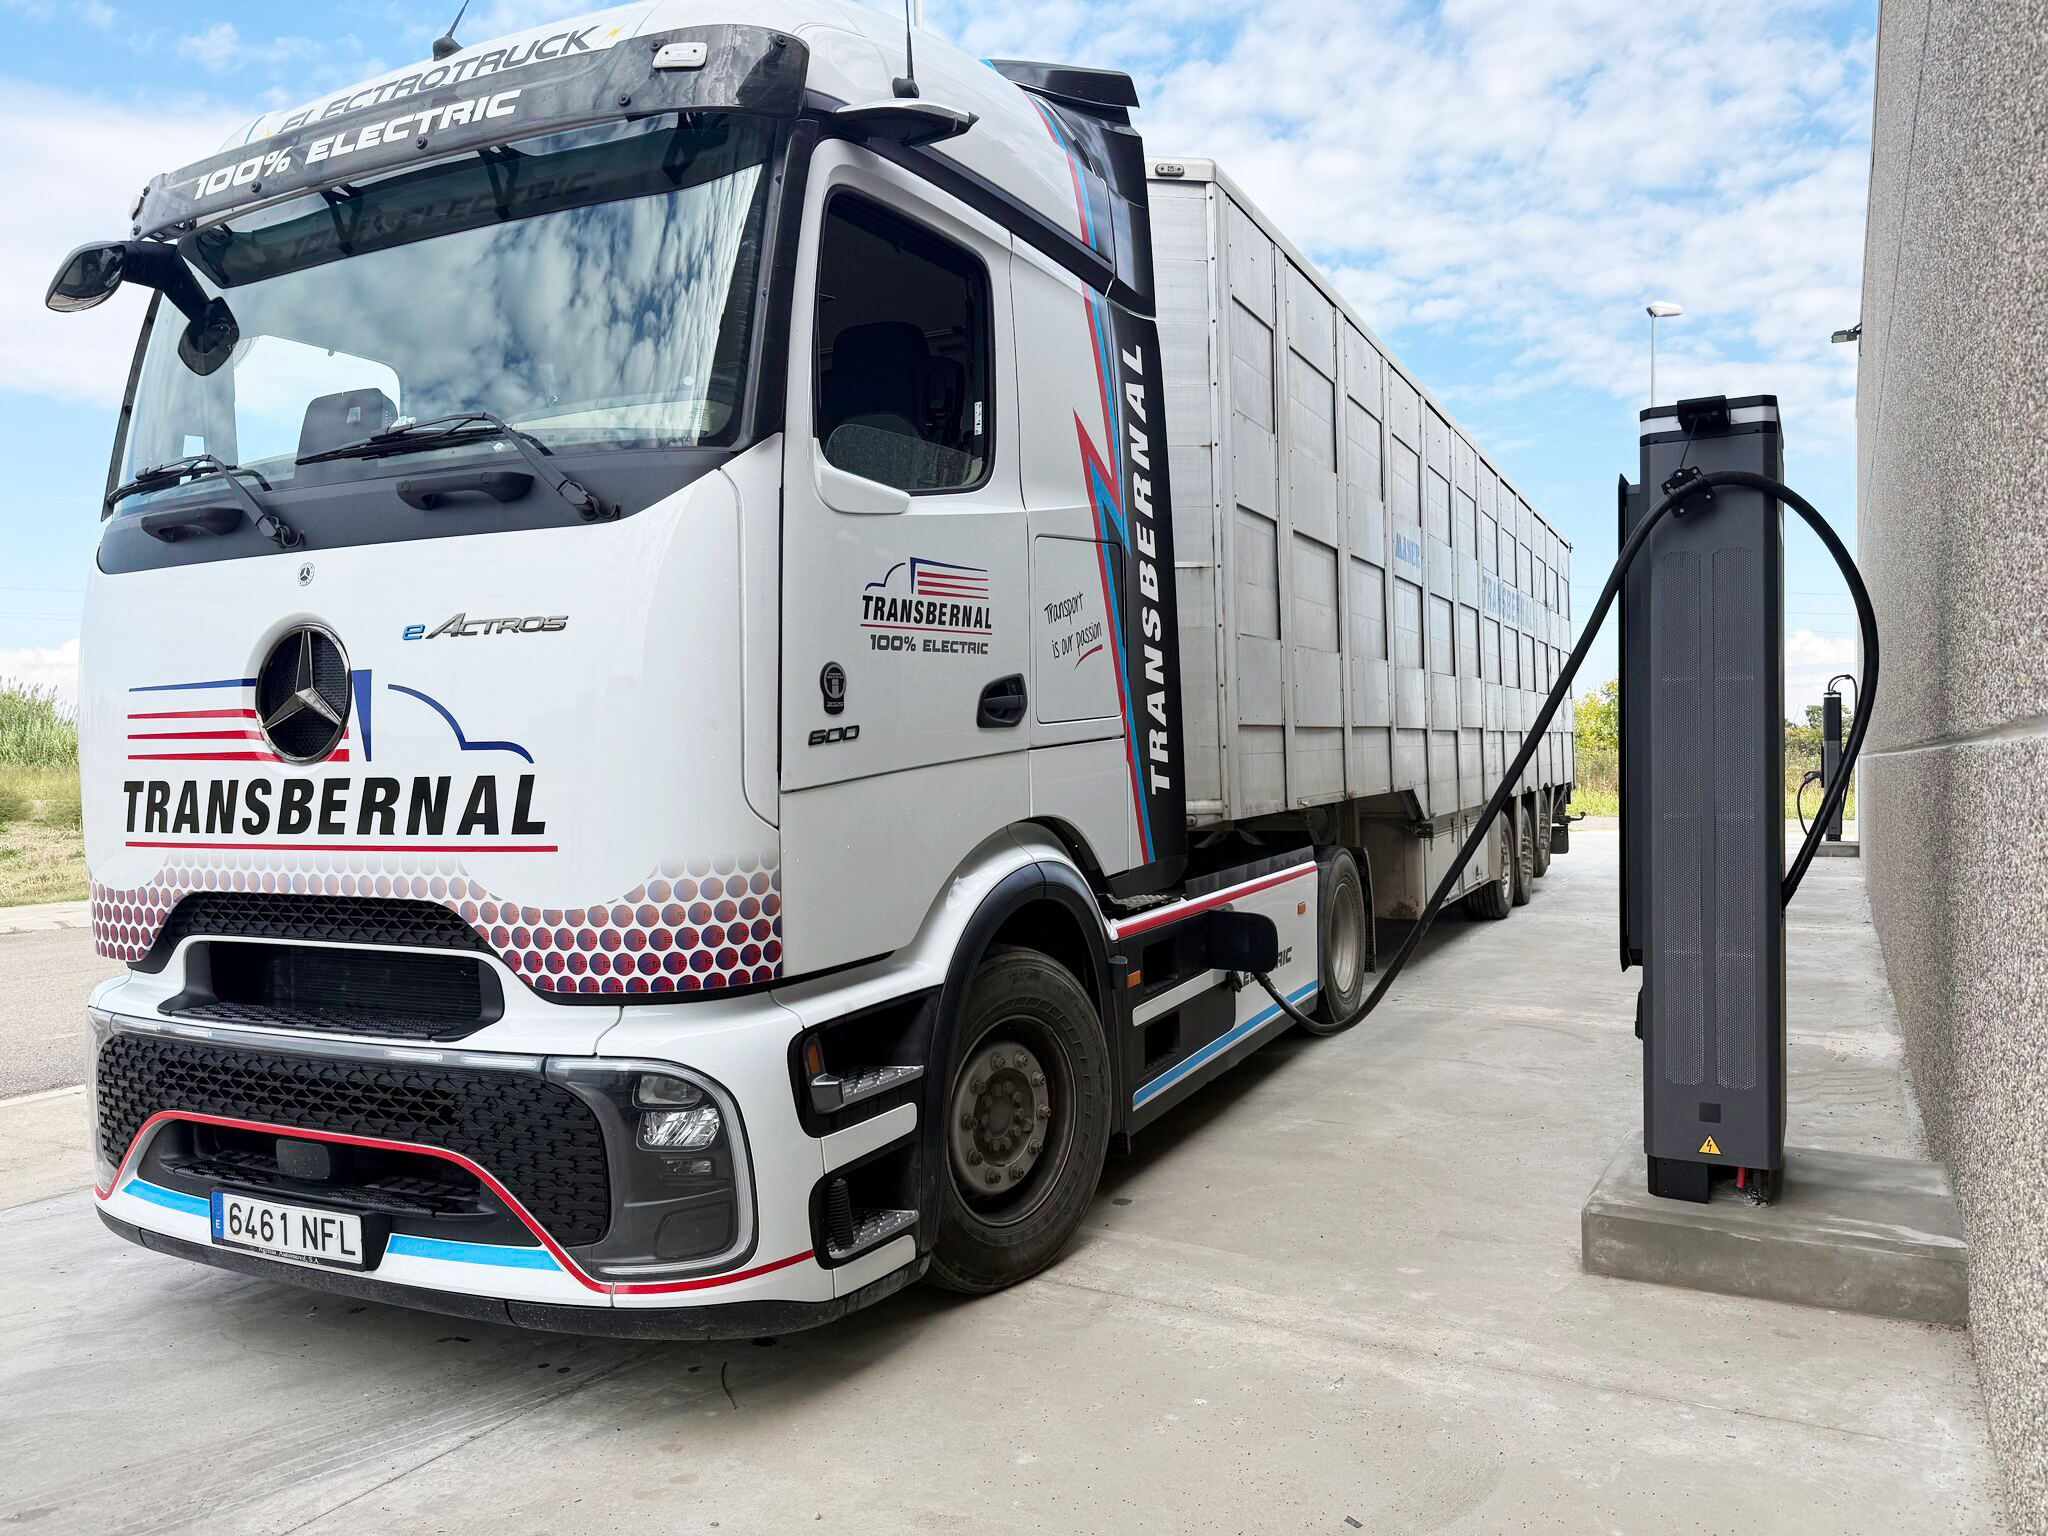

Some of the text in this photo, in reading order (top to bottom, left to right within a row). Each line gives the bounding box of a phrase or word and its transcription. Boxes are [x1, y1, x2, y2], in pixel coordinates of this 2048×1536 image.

[277, 24, 602, 134] ELECTROTRUCK
[194, 88, 523, 200] 100% ELECTRIC
[1122, 343, 1172, 796] TRANSBERNAL
[862, 594, 992, 629] TRANSBERNAL
[1043, 591, 1084, 625] Transport
[870, 634, 989, 655] 100% ELECTRIC
[1051, 620, 1103, 660] is our passion
[808, 724, 860, 746] 600
[123, 774, 547, 836] TRANSBERNAL
[215, 1219, 221, 1229] E
[229, 1202, 356, 1256] 6461 NFL
